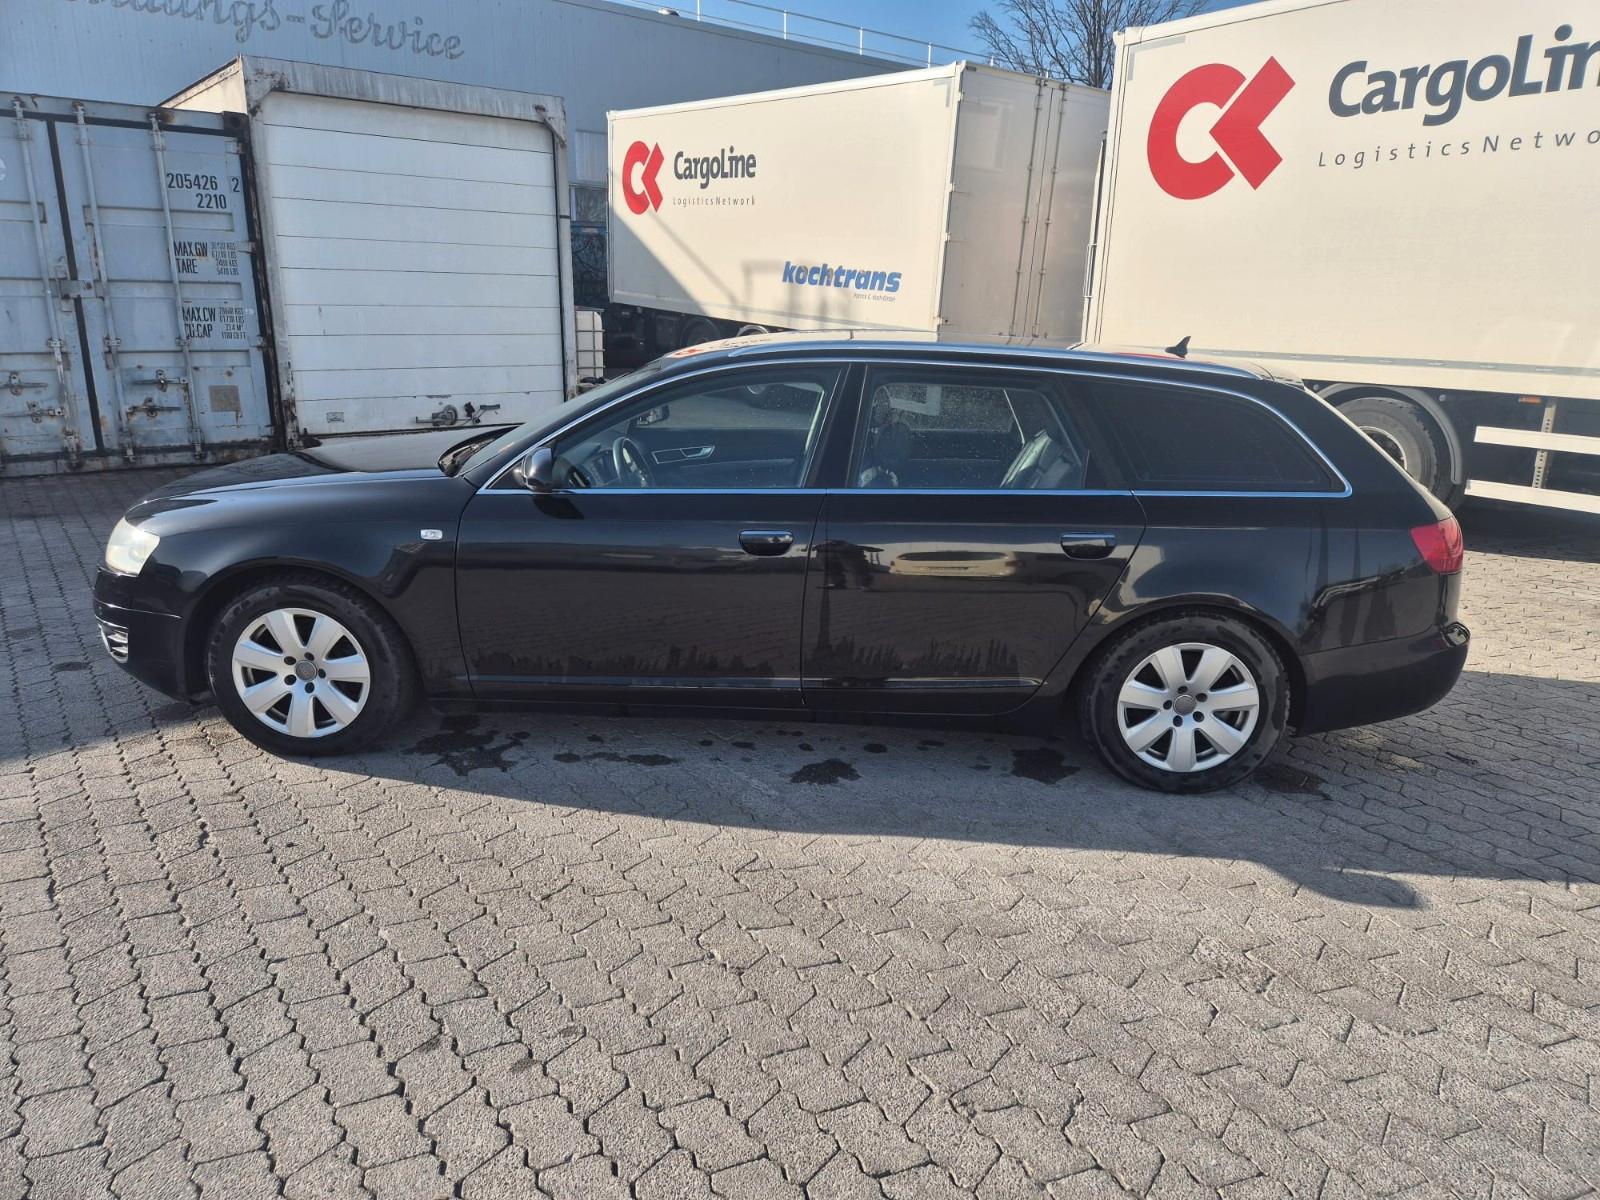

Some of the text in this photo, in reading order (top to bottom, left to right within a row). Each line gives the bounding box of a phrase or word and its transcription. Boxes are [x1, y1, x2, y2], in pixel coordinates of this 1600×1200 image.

[673, 145, 757, 189] CargoLine
[166, 172, 241, 193] 205426 2
[195, 192, 227, 209] 2210
[175, 258, 199, 274] TARE
[782, 260, 903, 293] kochtrans
